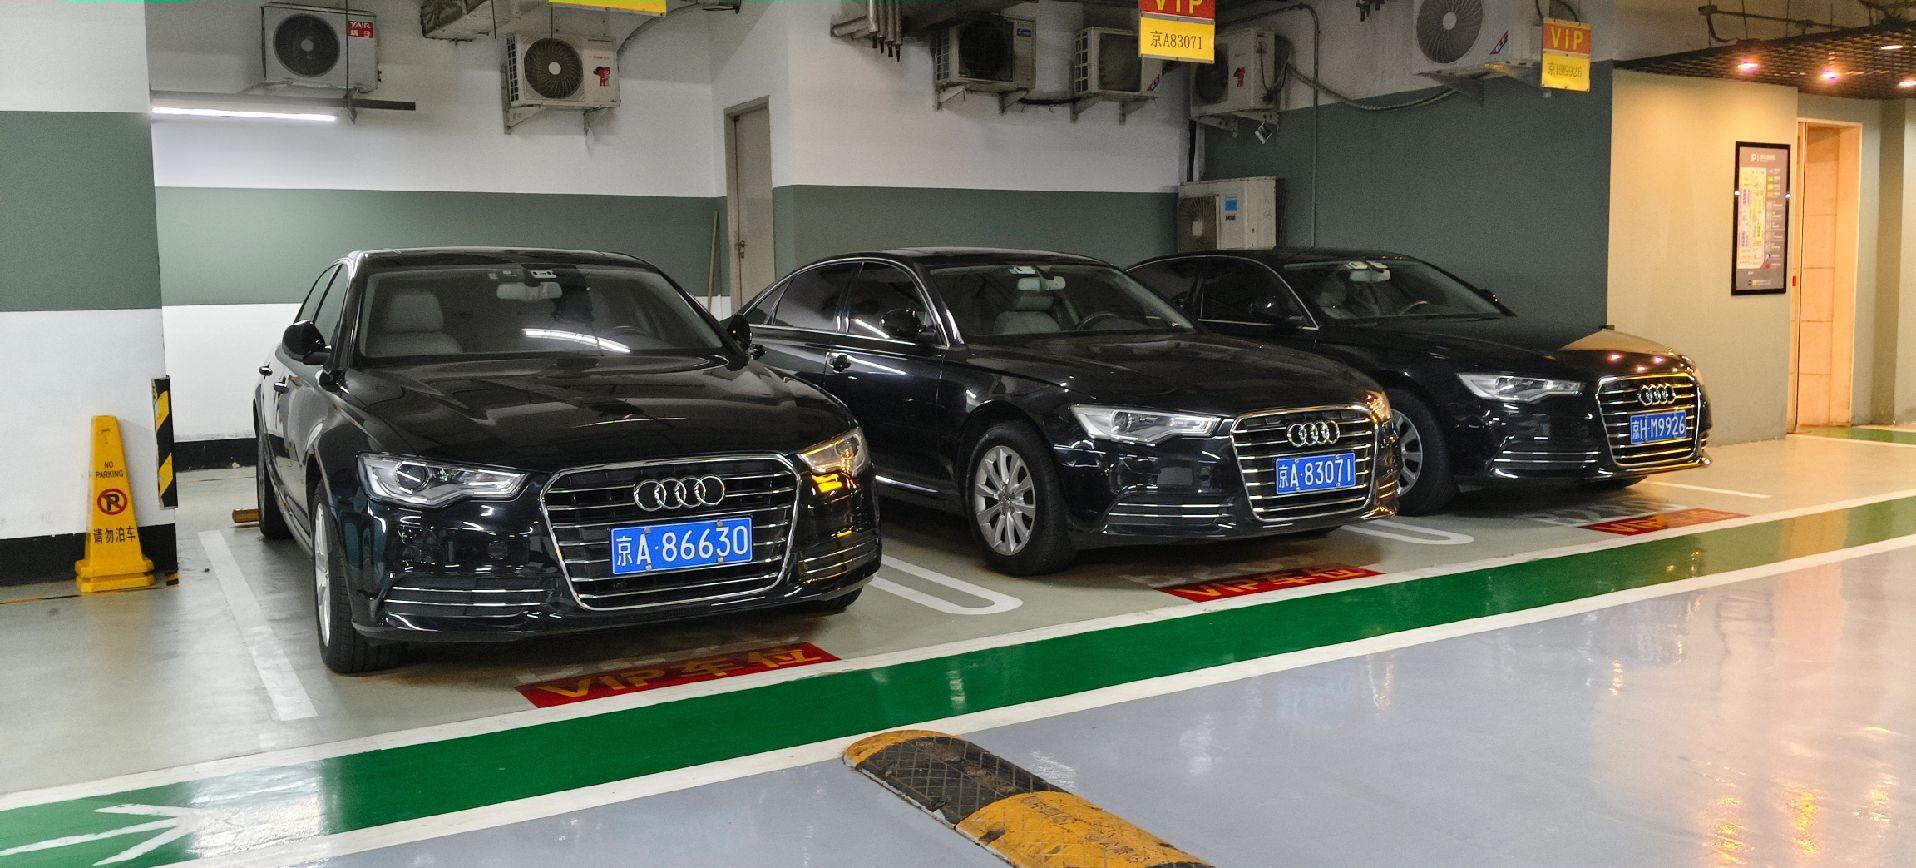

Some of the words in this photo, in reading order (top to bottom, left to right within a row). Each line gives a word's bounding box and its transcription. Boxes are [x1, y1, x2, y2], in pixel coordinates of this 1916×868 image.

[1150, 30, 1203, 50] 京A83071
[1551, 27, 1584, 50] VIP
[95, 469, 124, 479] PARKING
[104, 461, 114, 469] NO
[93, 525, 136, 544] 请勿泊车
